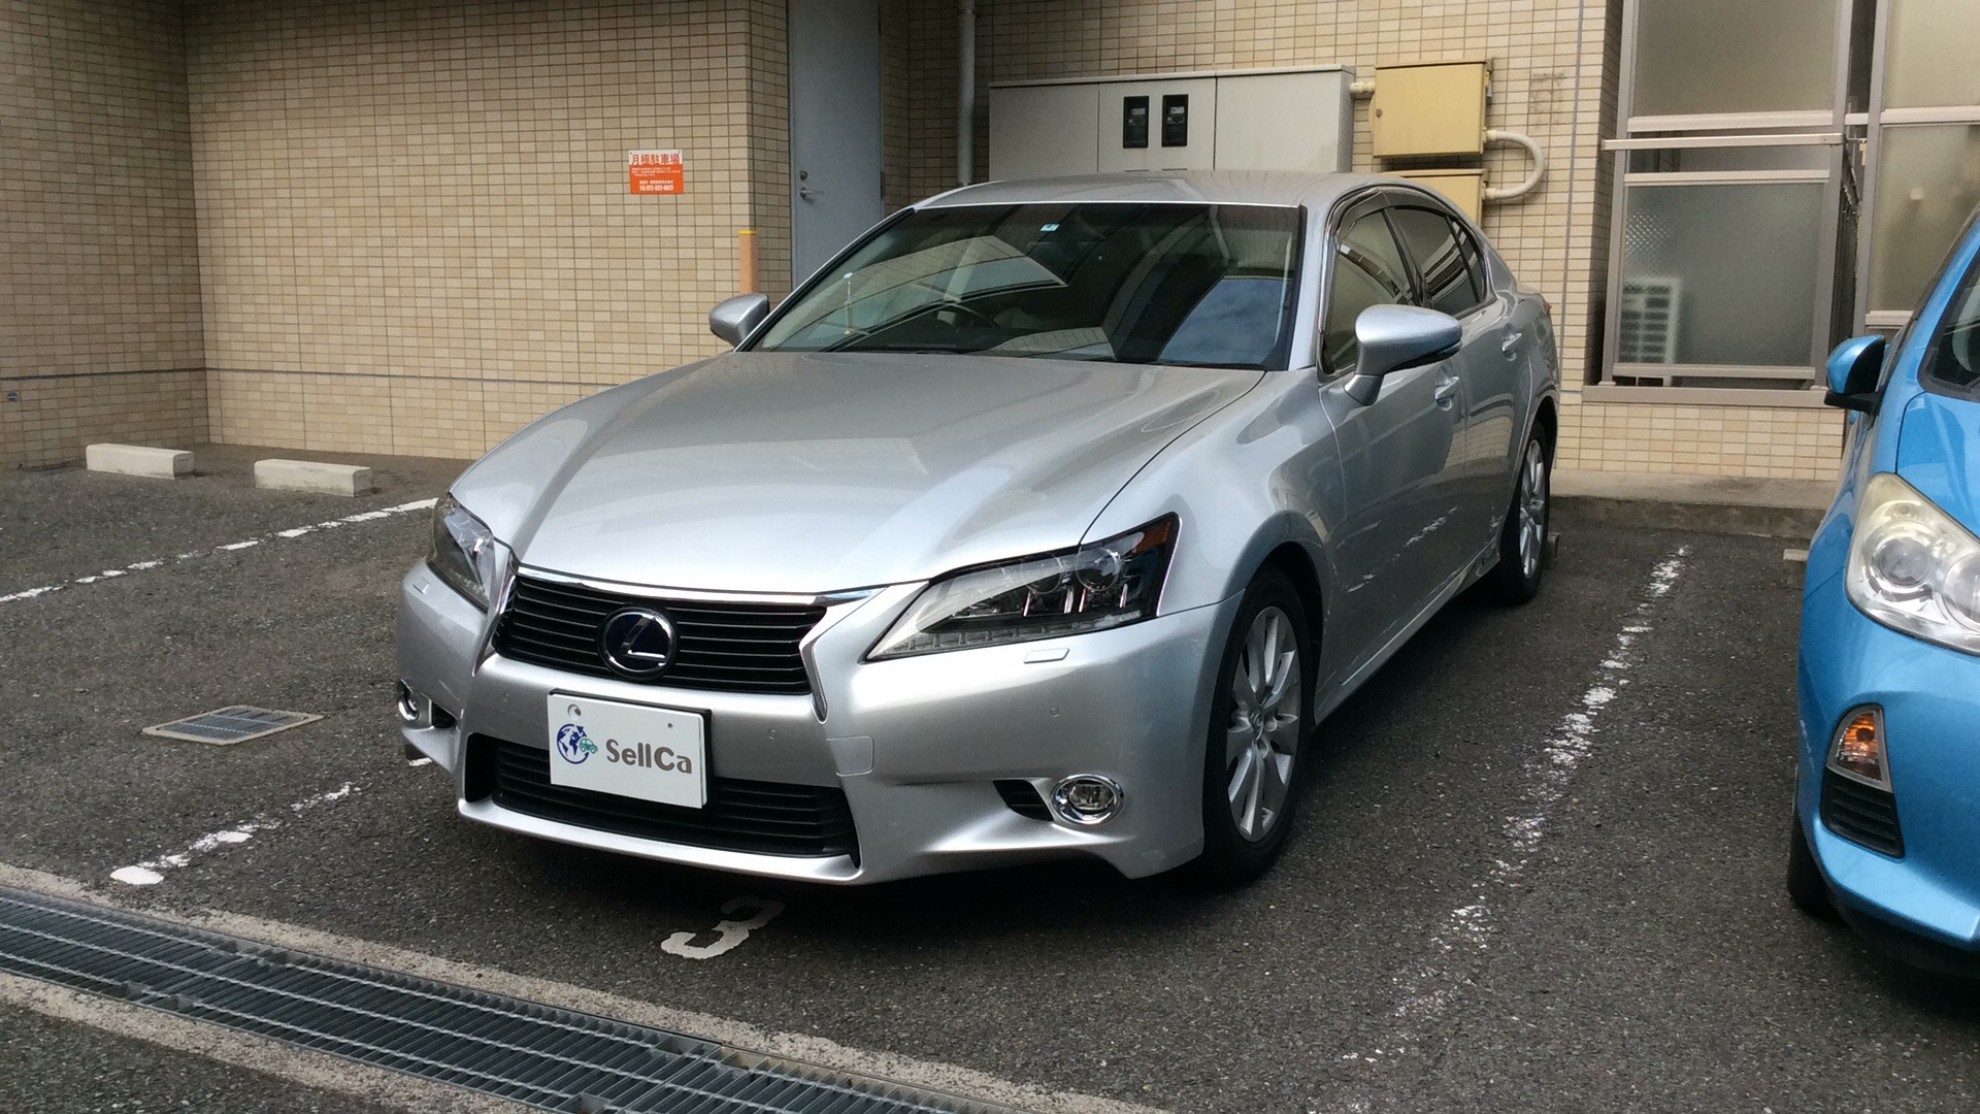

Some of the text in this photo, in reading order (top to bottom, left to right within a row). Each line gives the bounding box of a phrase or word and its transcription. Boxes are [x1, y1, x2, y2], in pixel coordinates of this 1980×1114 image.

[632, 153, 680, 165] 月極駐車場
[605, 738, 692, 774] SellCa
[660, 895, 786, 960] 3
